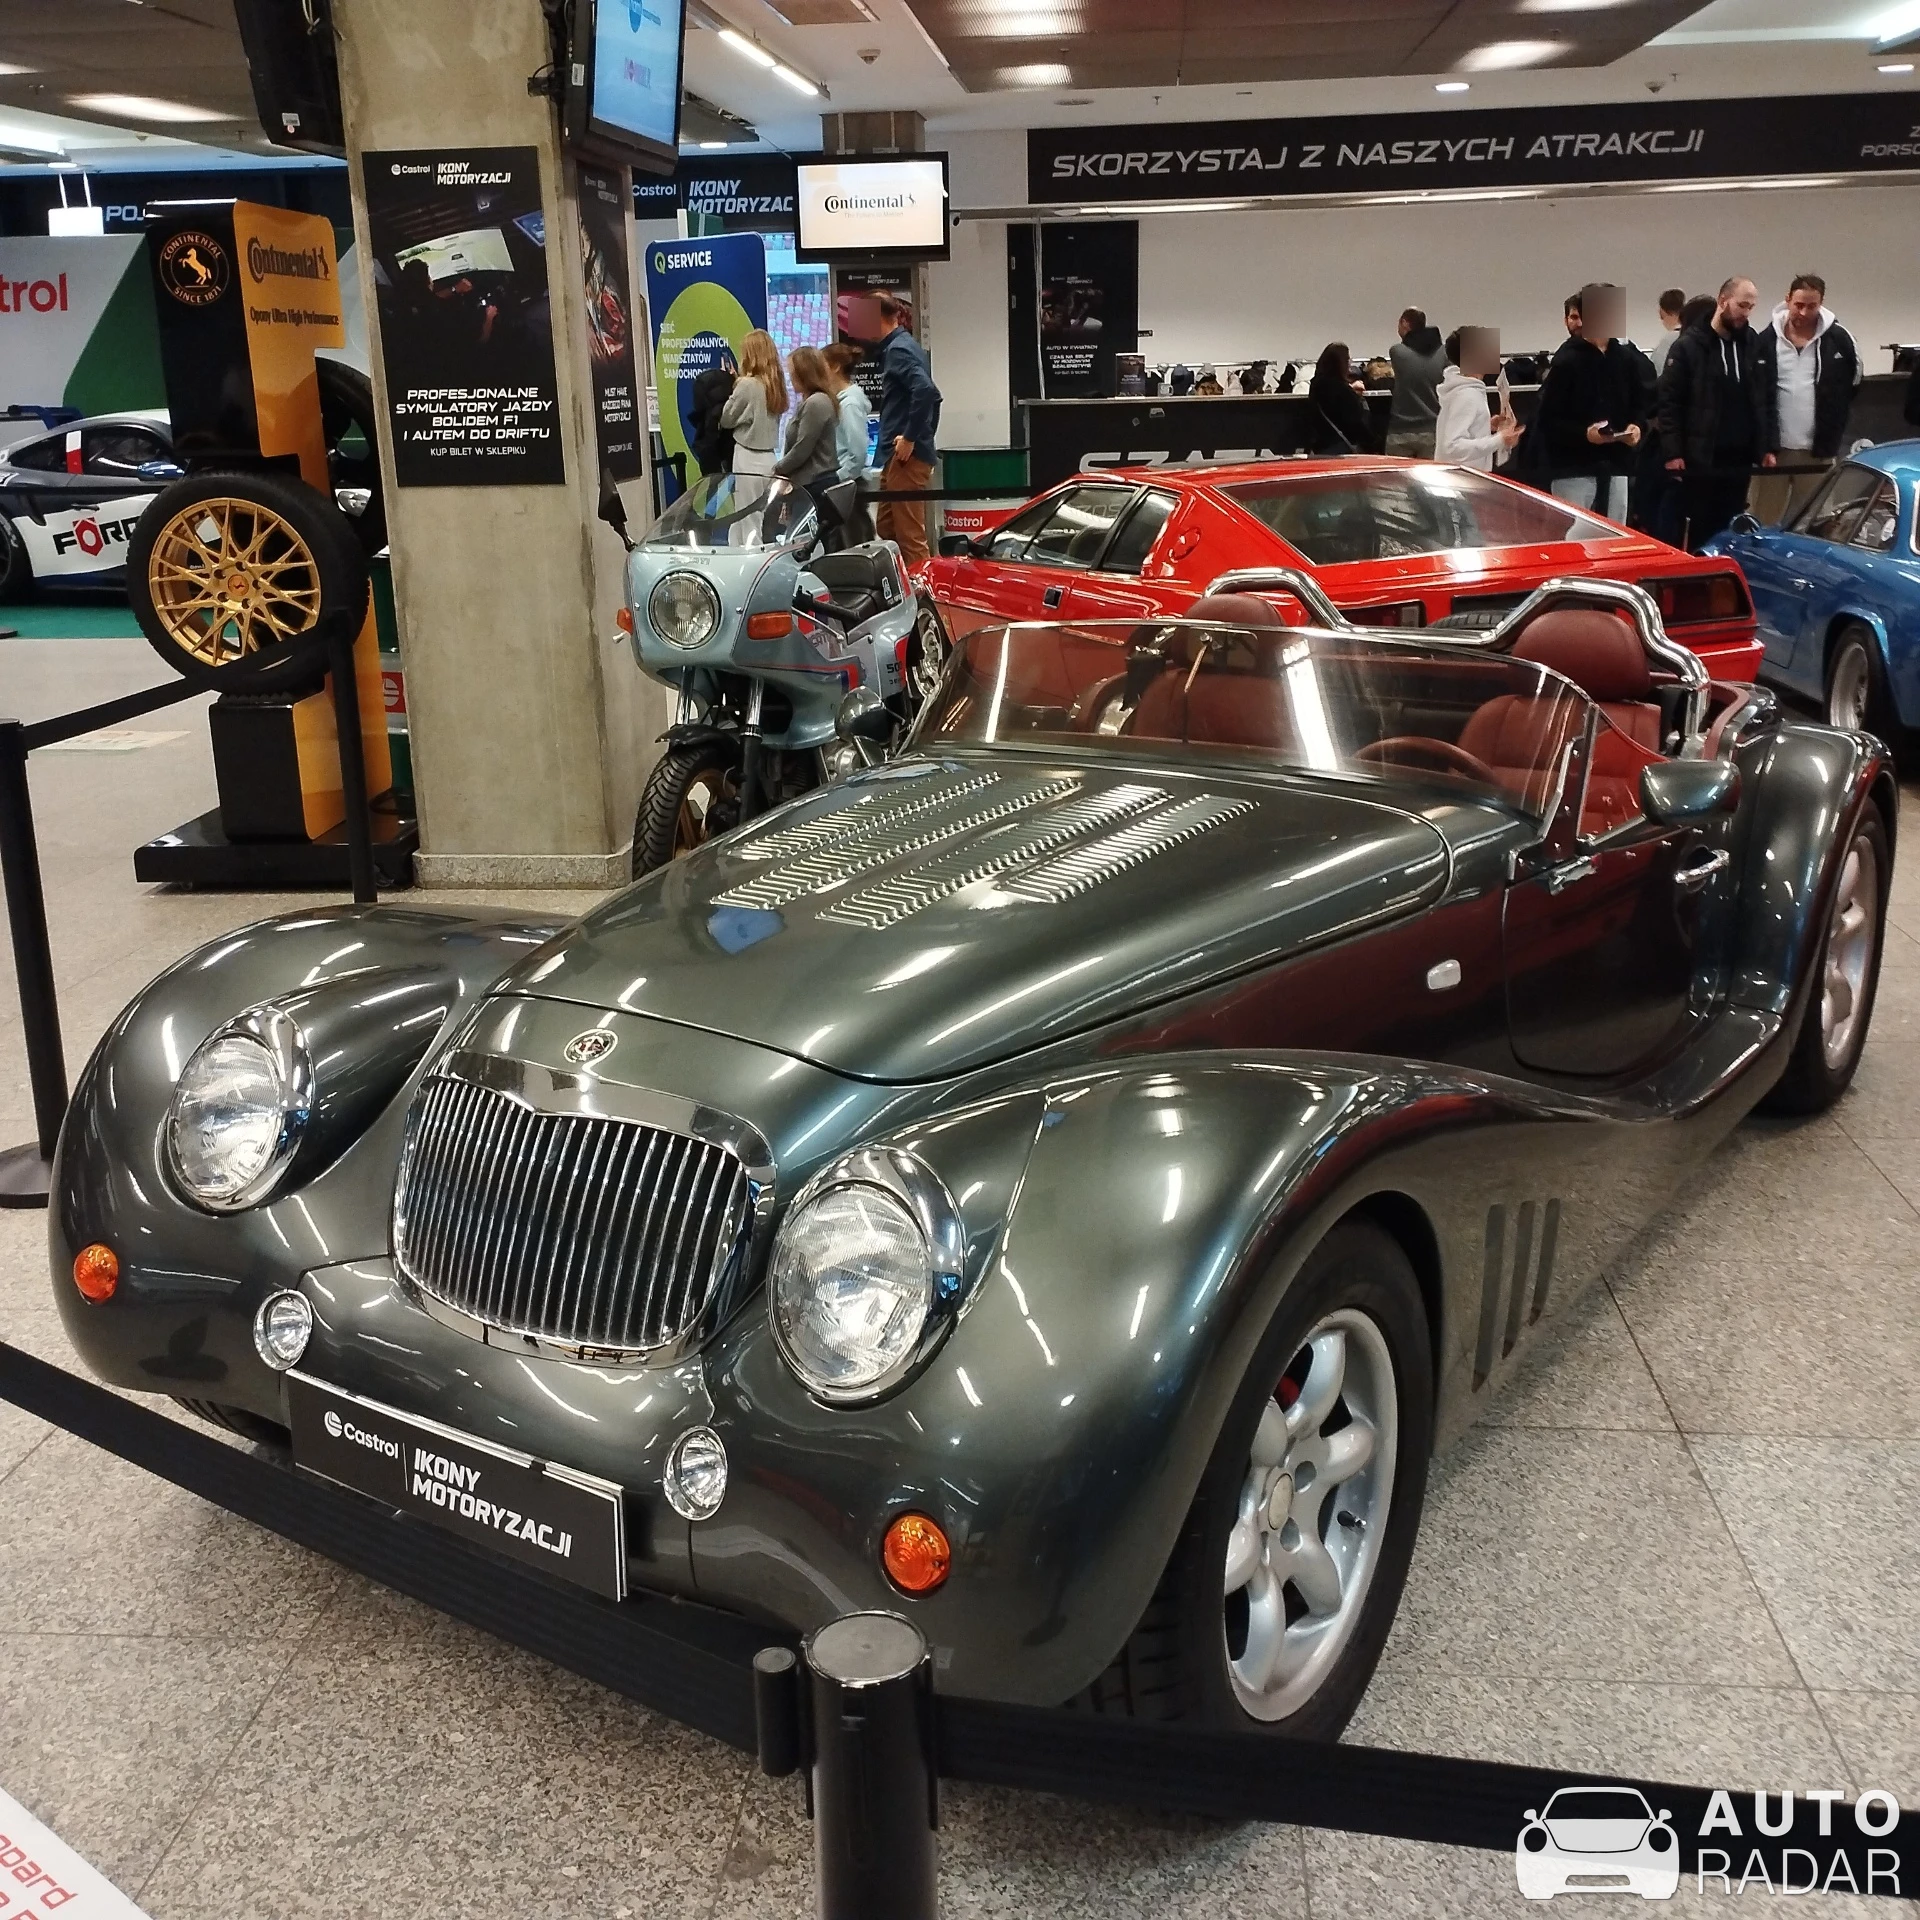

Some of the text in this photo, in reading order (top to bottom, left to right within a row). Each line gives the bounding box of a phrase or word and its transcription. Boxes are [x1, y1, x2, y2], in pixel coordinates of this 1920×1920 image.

[1052, 129, 1705, 177] SKORZYSTAJ Z NASZYCH ATRAKCJI
[401, 162, 470, 174] Castrol IKONY
[437, 172, 511, 185] MOTORYZACJI
[632, 183, 677, 197] Castrol
[689, 180, 741, 197] IKONY
[688, 196, 794, 214] MOTORYZAC
[824, 194, 904, 214] Continental
[105, 205, 145, 222] PO
[164, 234, 222, 260] CONTINENTAL
[247, 236, 320, 284] Continental
[667, 250, 713, 269] SERVICE
[174, 285, 222, 303] SINCE 1871
[250, 305, 271, 325] Opony
[271, 307, 287, 323] Ultra
[661, 337, 729, 348] PROFESJONALNYCH
[663, 350, 712, 364] WARSZTATÓW
[407, 387, 539, 400] PROFESJONALNE
[396, 400, 553, 414] SYMULATORY JAZDY
[432, 415, 519, 427] BOLIDEM F1
[403, 428, 550, 441] I AUTEM DO DRIFTU
[430, 446, 526, 456] KUP BILET W SKLEPIKU
[947, 516, 983, 527] Castrol
[343, 1422, 482, 1492] Castrol IKONY
[412, 1474, 573, 1558] MOTORYZACJI
